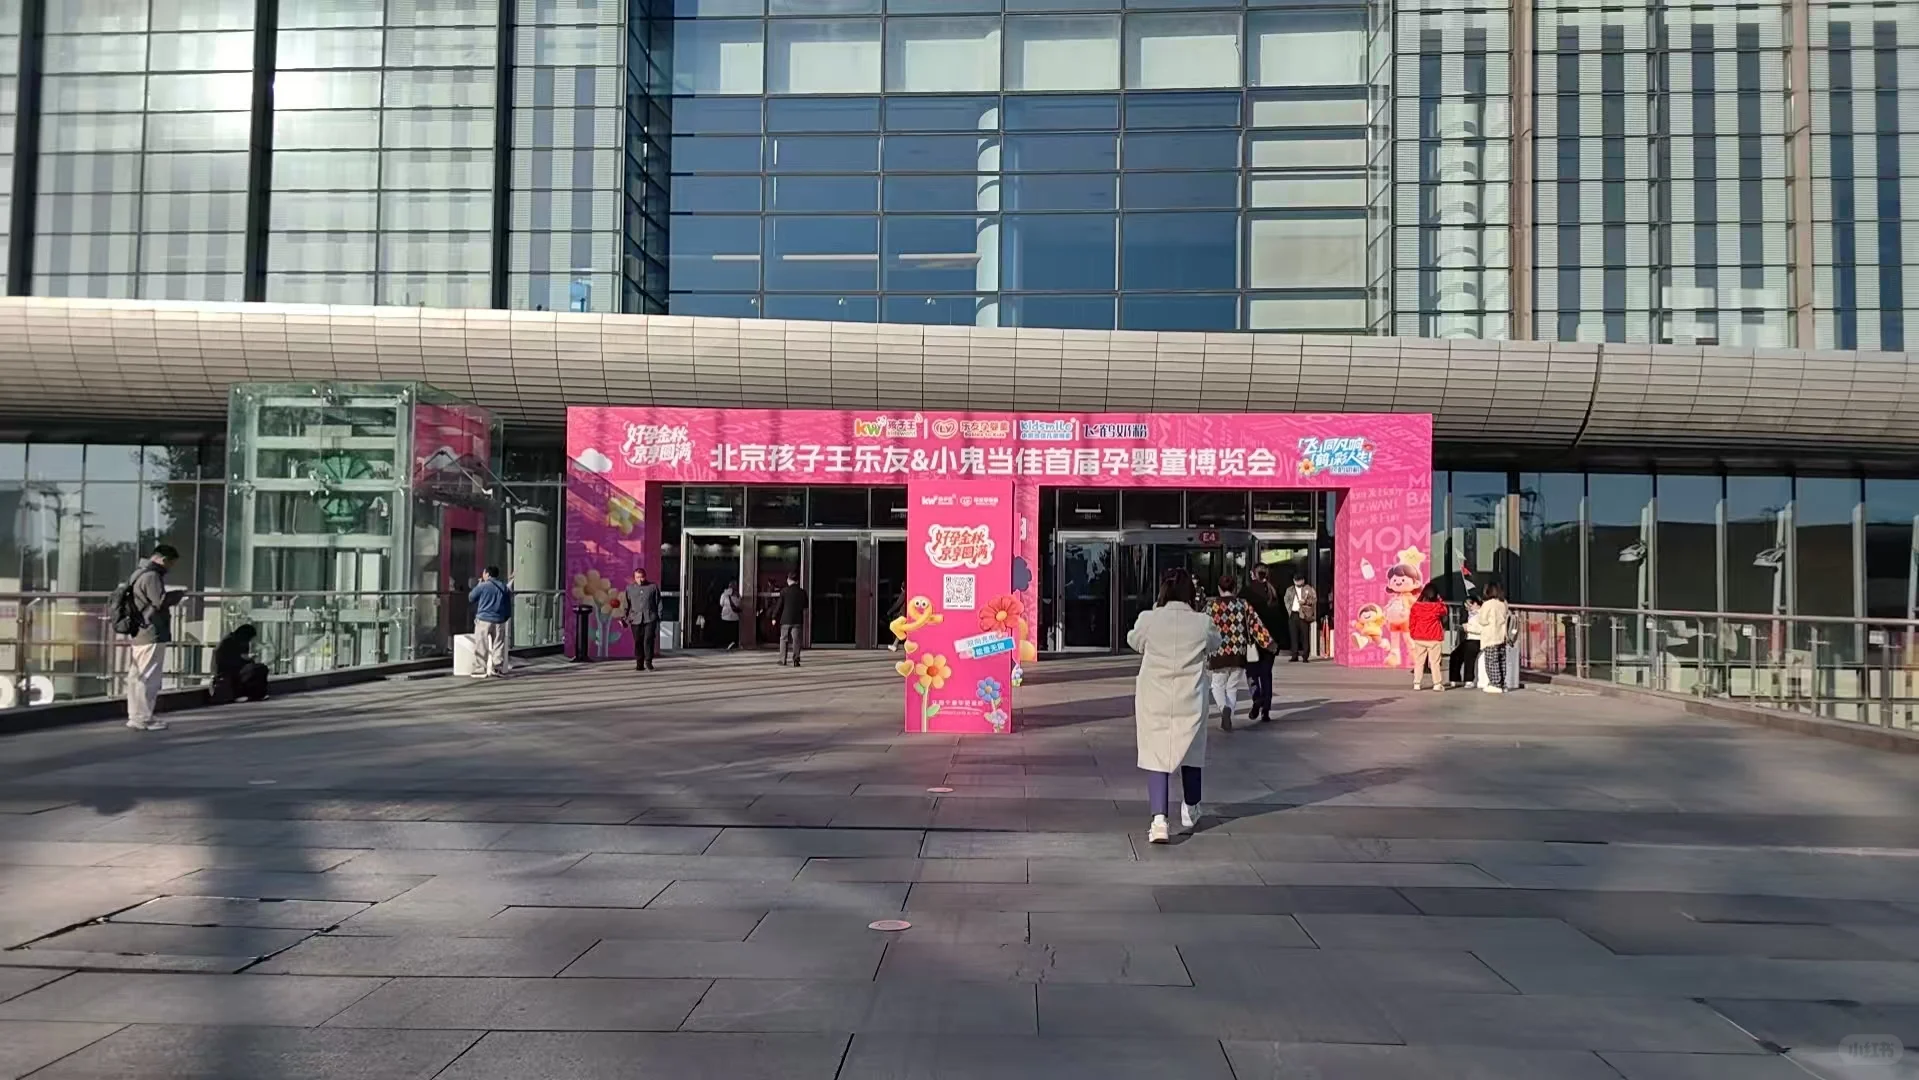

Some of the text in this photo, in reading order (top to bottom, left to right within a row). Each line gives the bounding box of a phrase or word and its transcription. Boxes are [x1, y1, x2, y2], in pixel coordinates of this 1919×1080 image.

[887, 420, 916, 431] 孩子王
[623, 424, 688, 452] 好孕金秋
[710, 444, 1276, 477] 北京孩子王乐友&小鬼当佳首届孕婴童博览会
[932, 530, 985, 552] 好孕金秋
[1202, 532, 1216, 541] E4
[938, 545, 988, 563] 京享圆满
